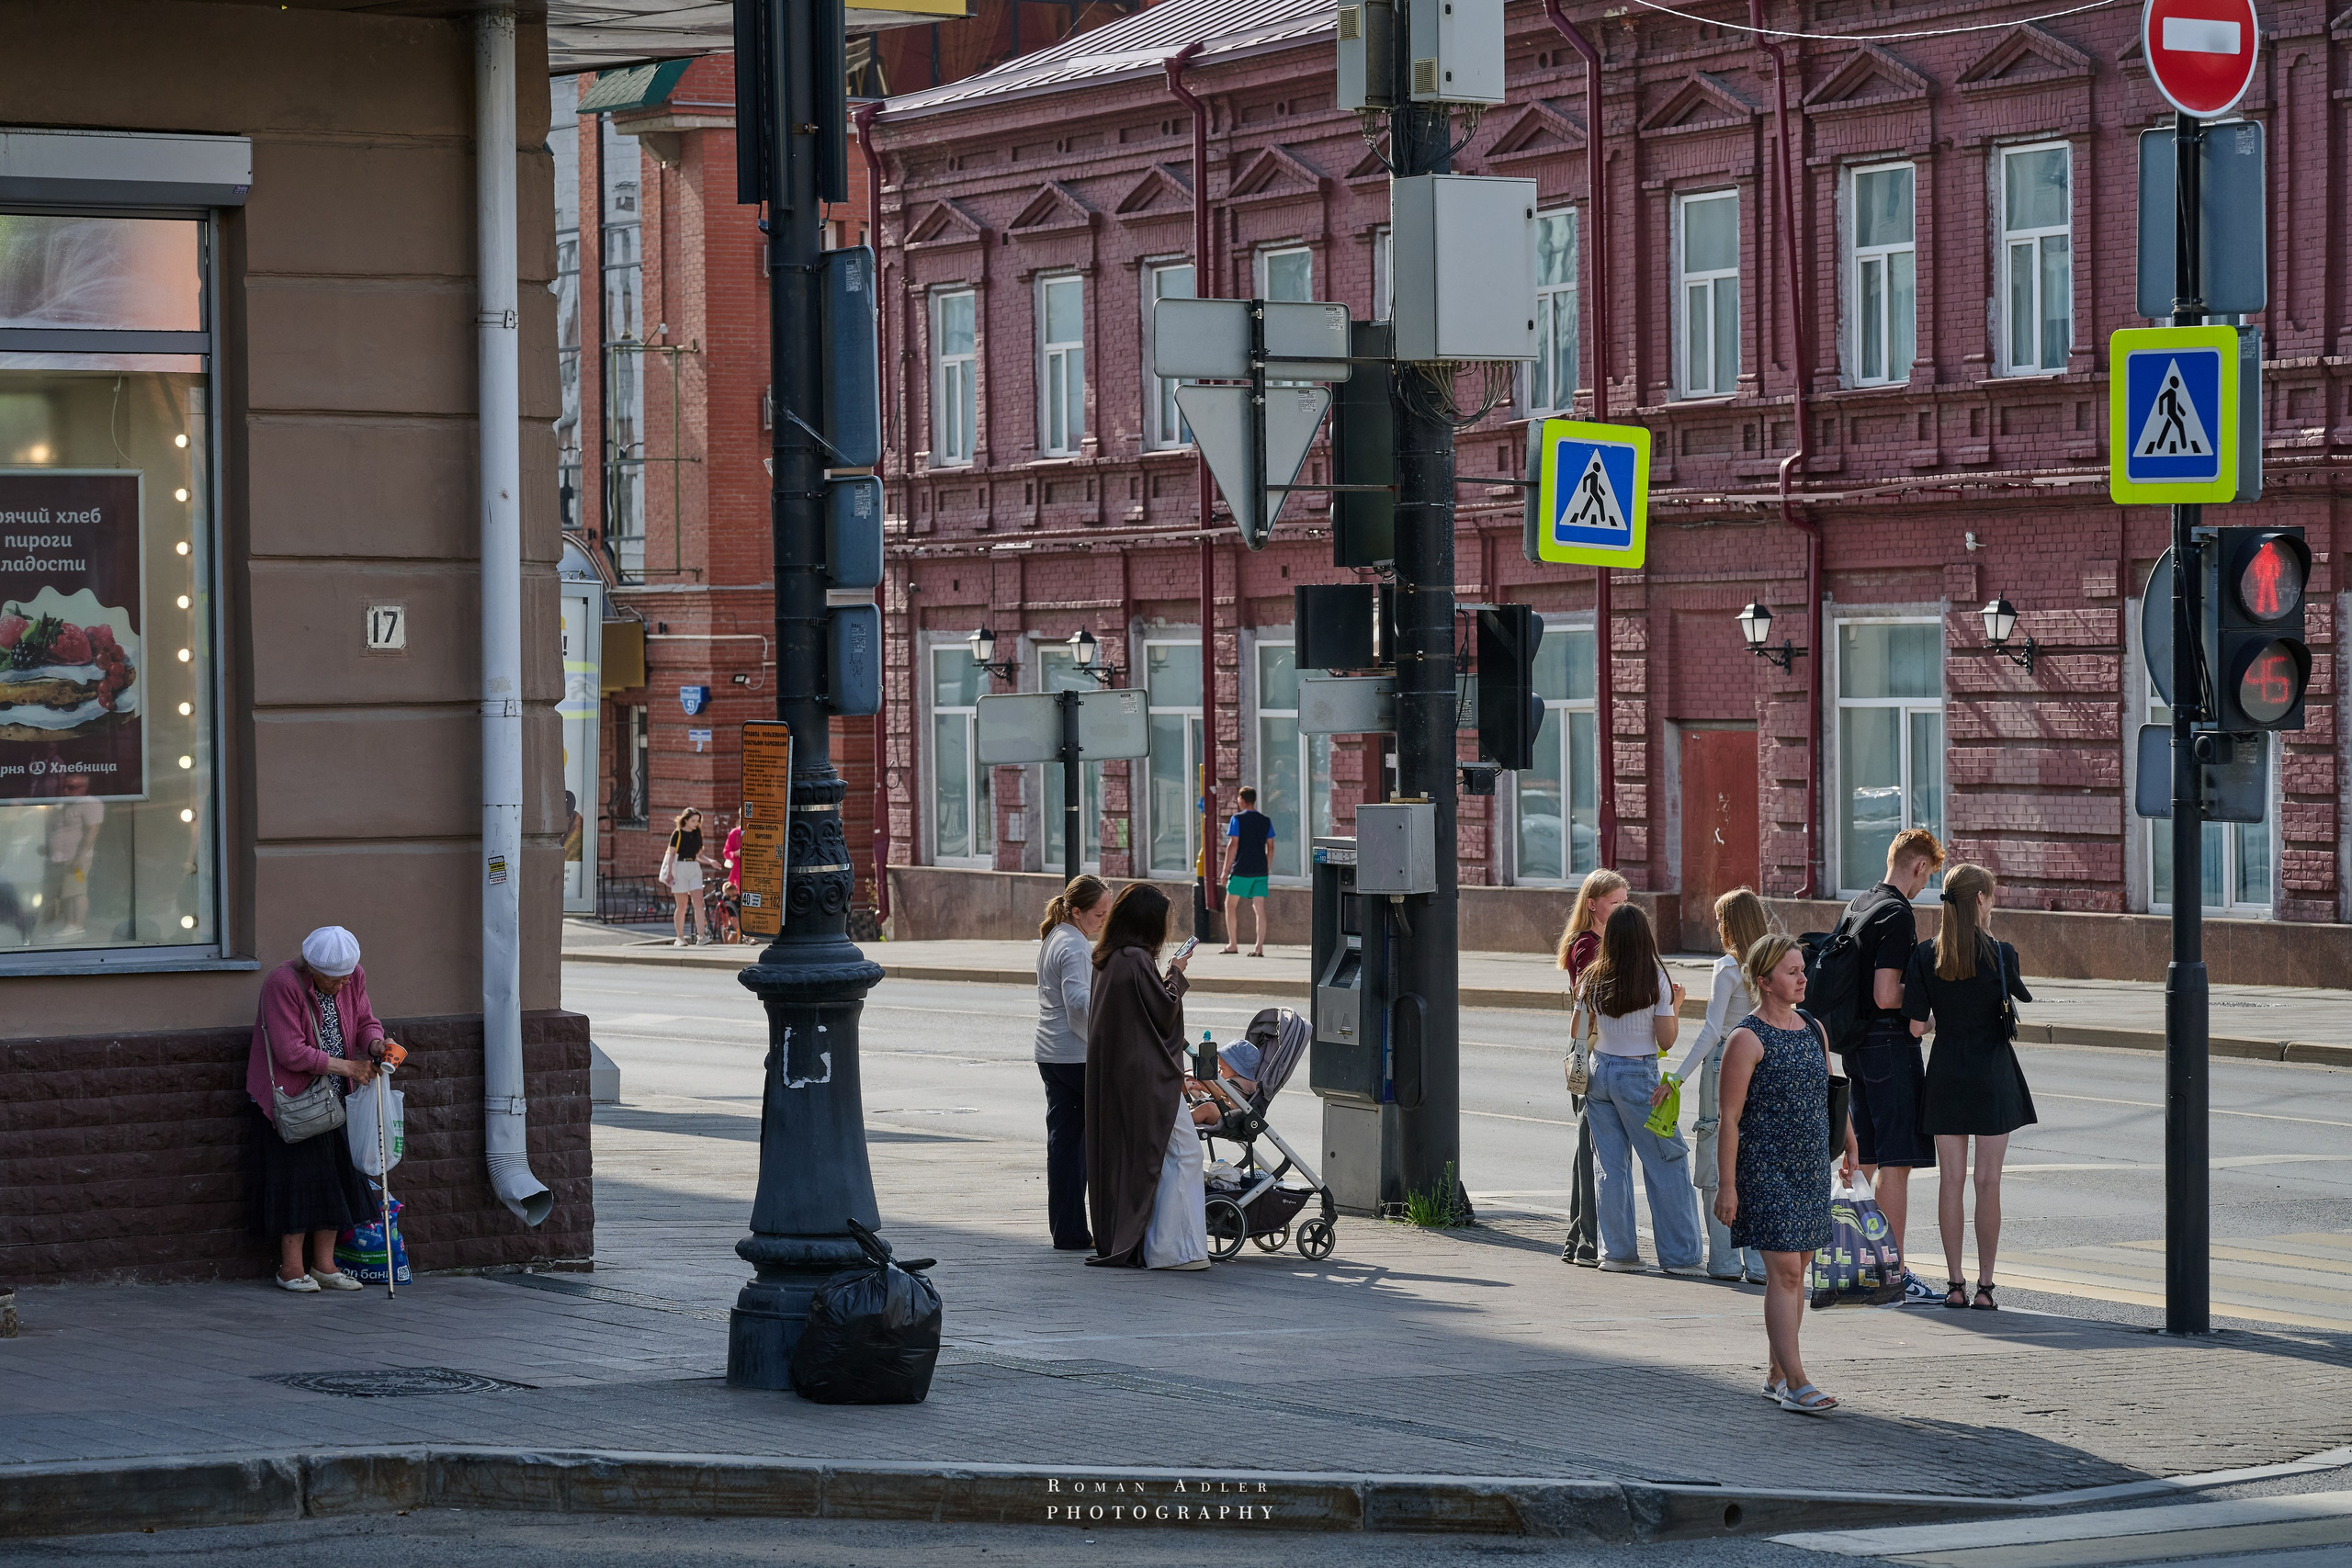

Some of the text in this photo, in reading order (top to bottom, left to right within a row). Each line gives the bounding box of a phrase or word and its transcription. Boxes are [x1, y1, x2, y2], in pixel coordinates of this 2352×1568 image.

[56, 507, 102, 524] хлеб
[5, 535, 73, 552] пироги
[0, 555, 86, 571] ладости
[373, 611, 398, 643] 17
[2245, 655, 2289, 704] 45
[50, 761, 118, 774] Хлебница
[742, 893, 751, 906] 40
[770, 896, 780, 908] 102
